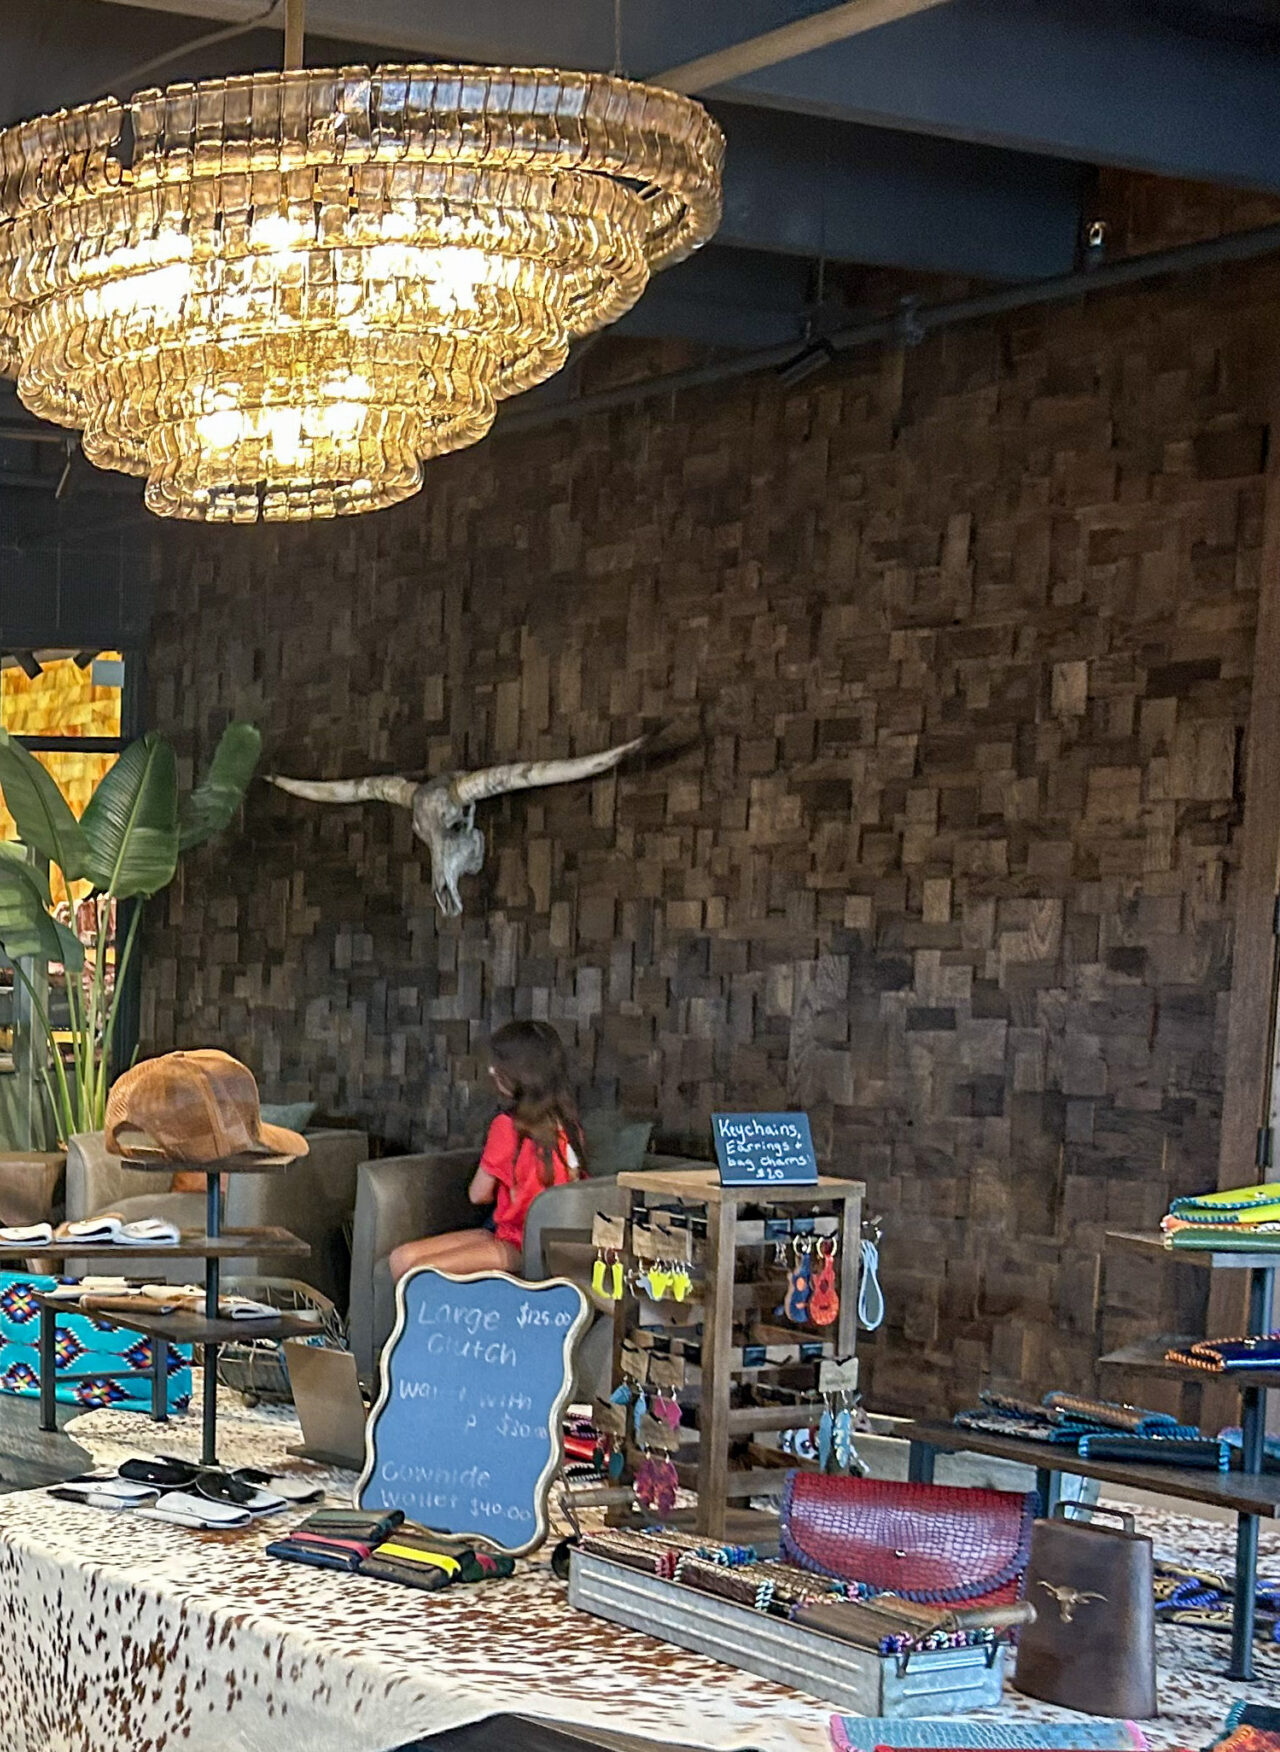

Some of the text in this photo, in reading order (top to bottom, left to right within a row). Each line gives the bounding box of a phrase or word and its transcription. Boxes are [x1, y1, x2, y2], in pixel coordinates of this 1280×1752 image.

[719, 1118, 801, 1144] Keychains,
[726, 1140, 790, 1156] Earrings
[727, 1157, 755, 1171] bag
[756, 1168, 784, 1179] $20
[418, 1301, 571, 1334] Large $125.00
[381, 1459, 492, 1488] Cowhide
[469, 1497, 532, 1521] $40.00
